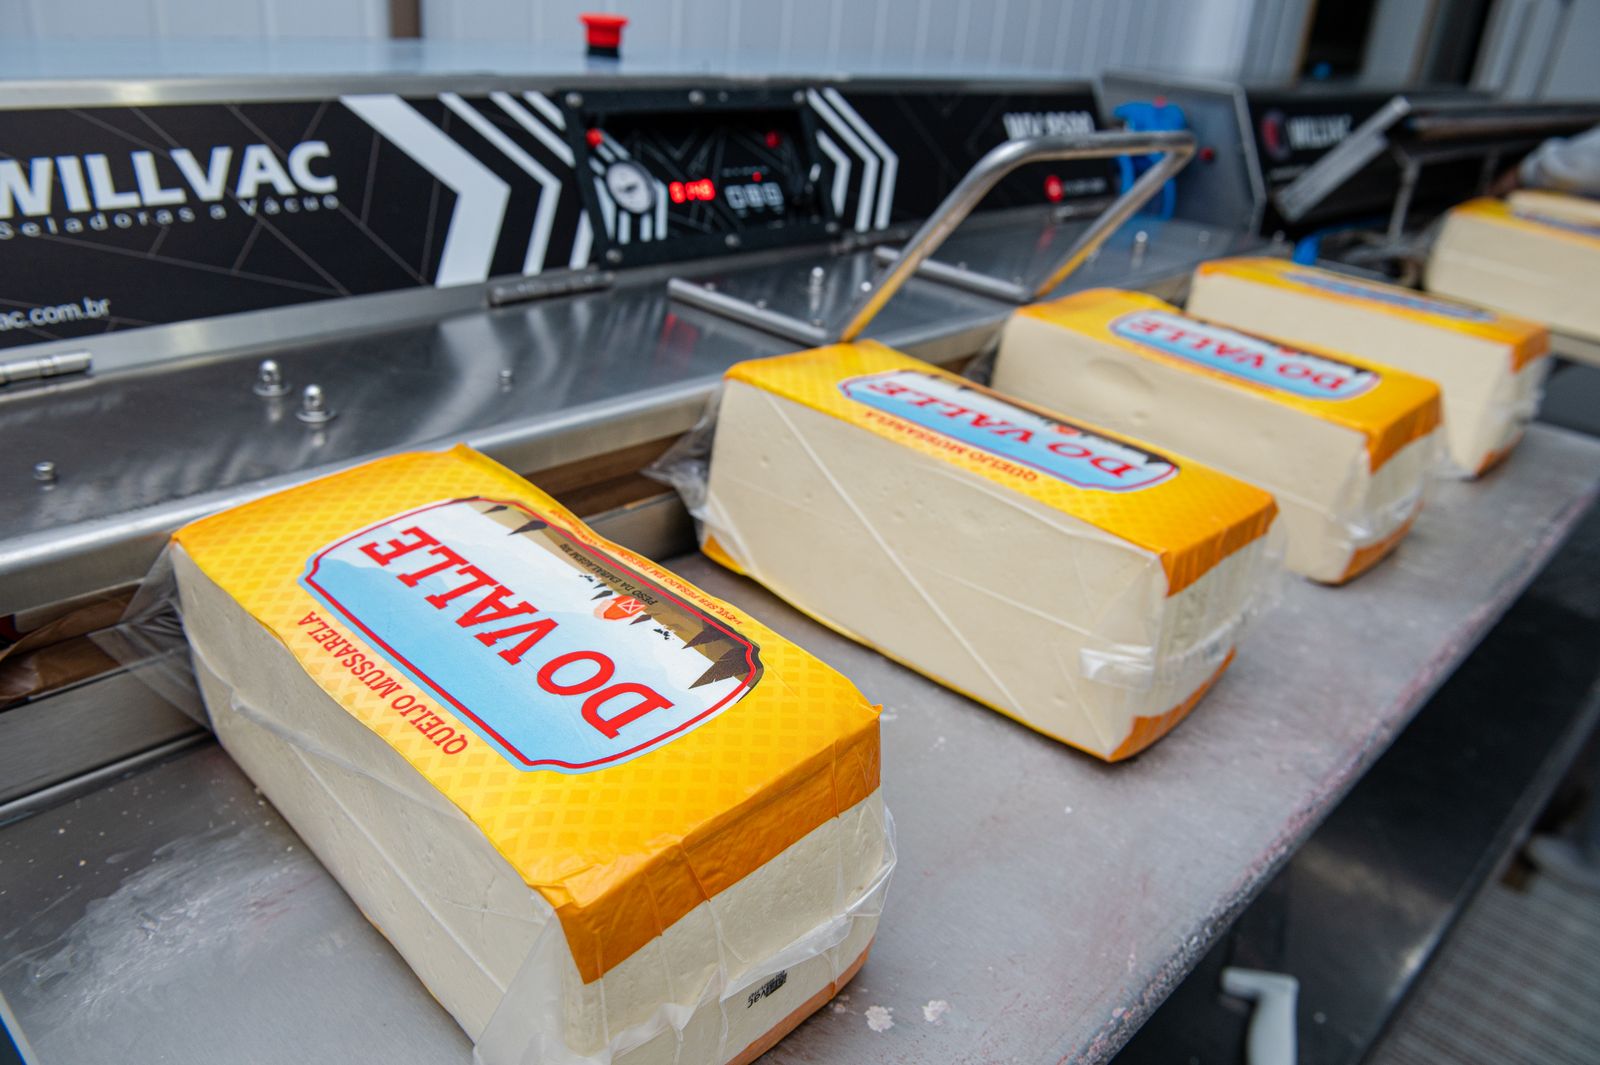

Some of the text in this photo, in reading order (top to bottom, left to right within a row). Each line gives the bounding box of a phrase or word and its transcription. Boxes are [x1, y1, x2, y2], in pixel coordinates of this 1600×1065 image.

[1128, 318, 1265, 369] VALLE
[1278, 362, 1348, 391] DO
[865, 381, 1138, 479] DO VALLE
[968, 451, 1038, 482] QUEIJO
[571, 551, 622, 584] EMBALAGEM
[620, 582, 635, 592] DA
[632, 590, 658, 605] PESO
[358, 526, 675, 739] DO VALLE
[297, 611, 469, 755] QUEIJO MUSSARELA
